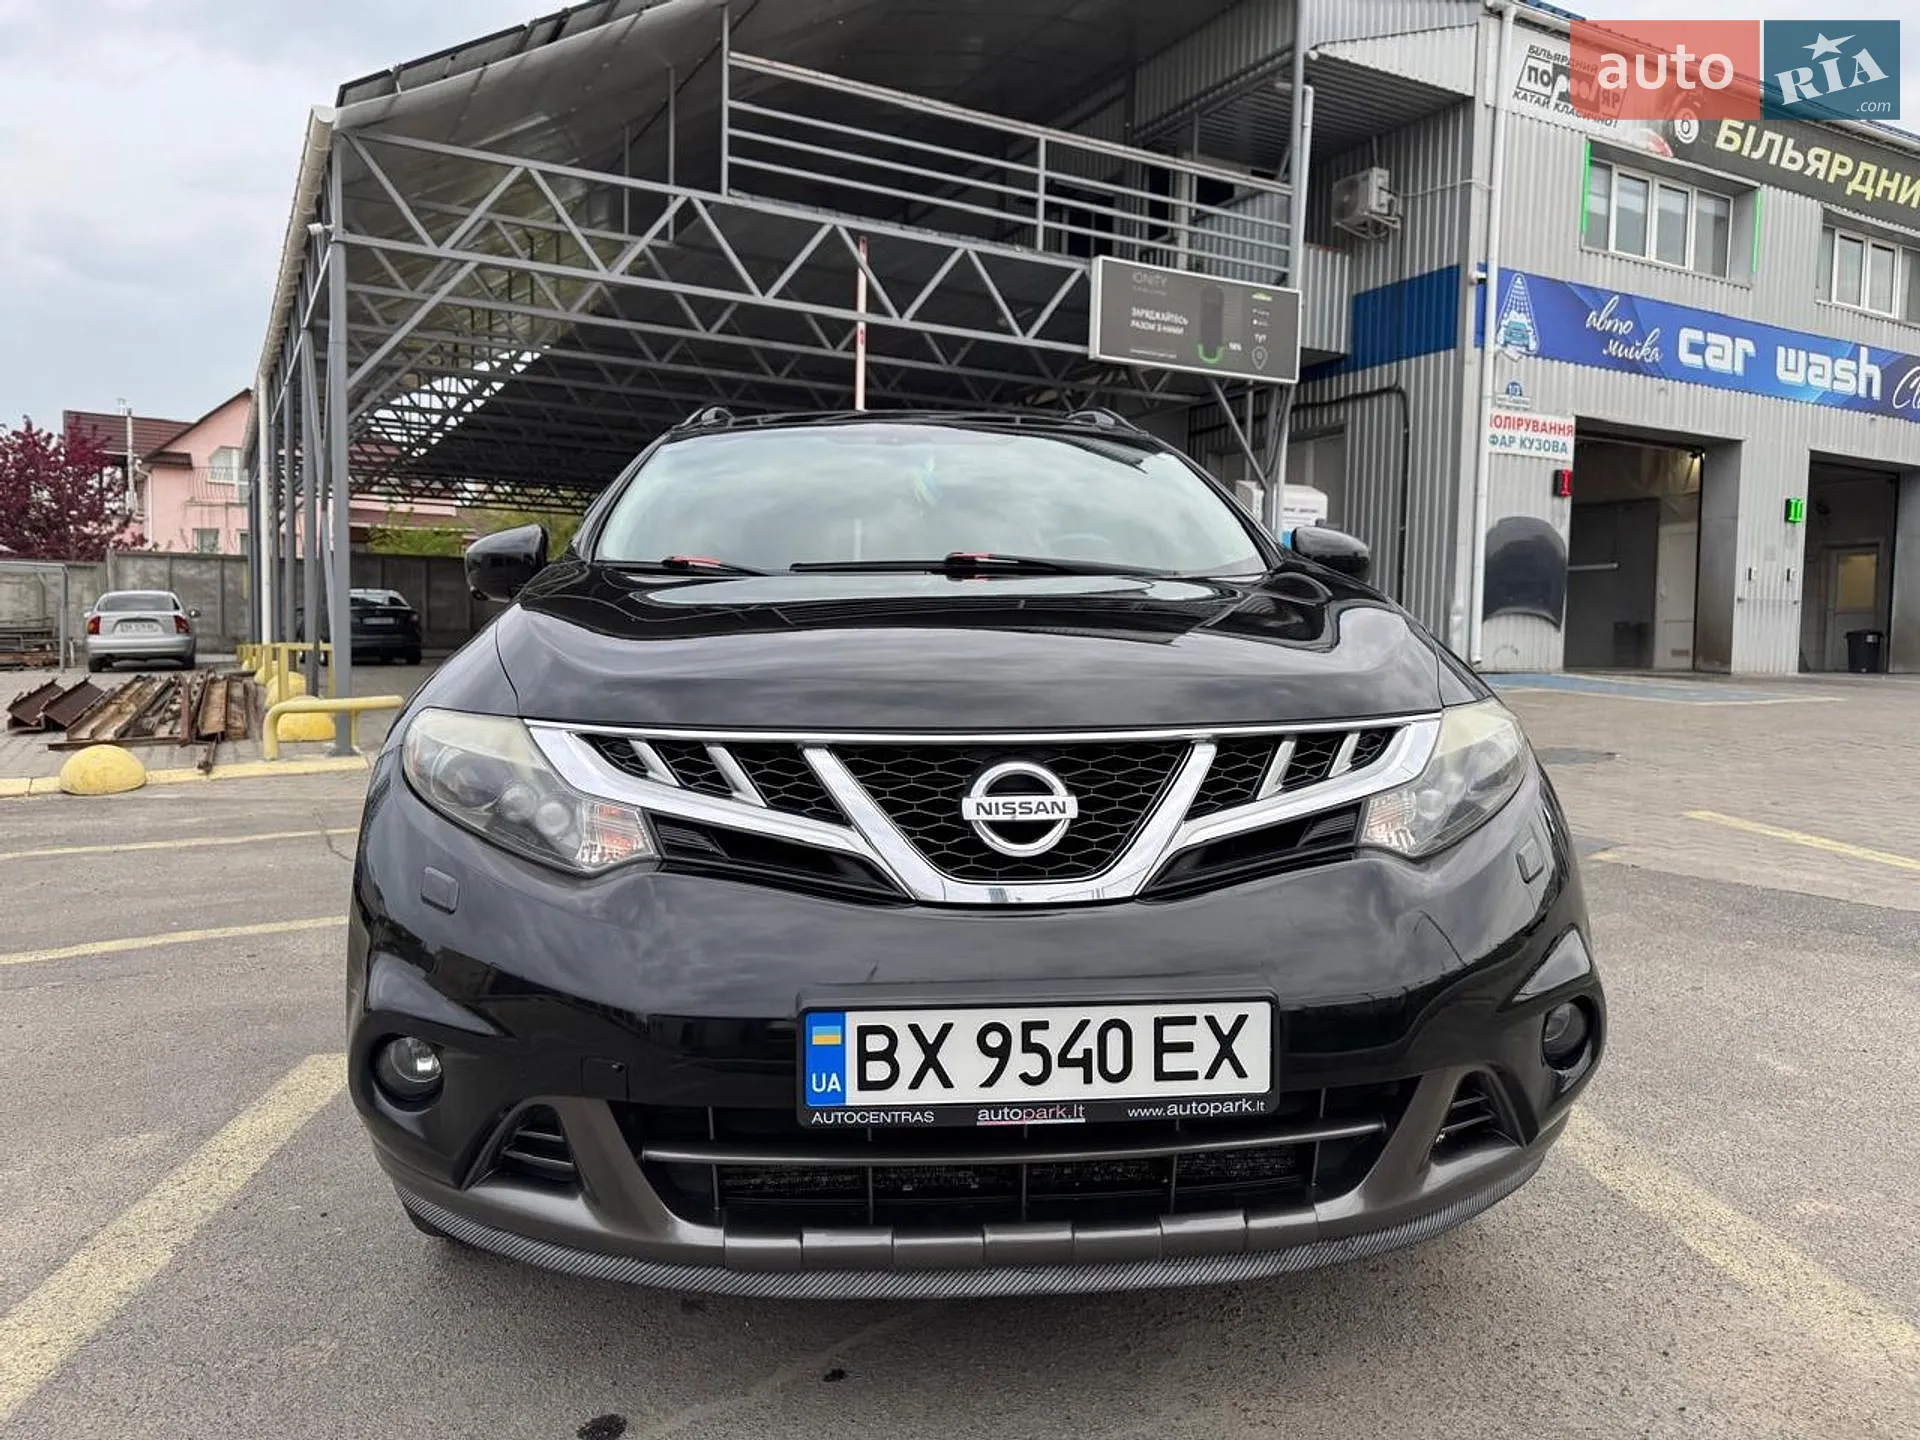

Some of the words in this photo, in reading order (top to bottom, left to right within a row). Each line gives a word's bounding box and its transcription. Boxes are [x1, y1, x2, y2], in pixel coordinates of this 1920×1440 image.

[1678, 327, 1757, 376] car
[1775, 346, 1882, 401] wash
[1520, 435, 1568, 455] КУЗОВА
[975, 800, 1067, 816] NISSAN
[811, 1072, 842, 1093] UA
[856, 1022, 955, 1091] BX
[976, 1018, 1134, 1089] 9540
[1153, 1013, 1250, 1082] EX
[811, 1110, 936, 1125] AUTOCENTRAS
[977, 1103, 1086, 1122] autopark.lt
[1127, 1097, 1266, 1119] www.autopark.lt
